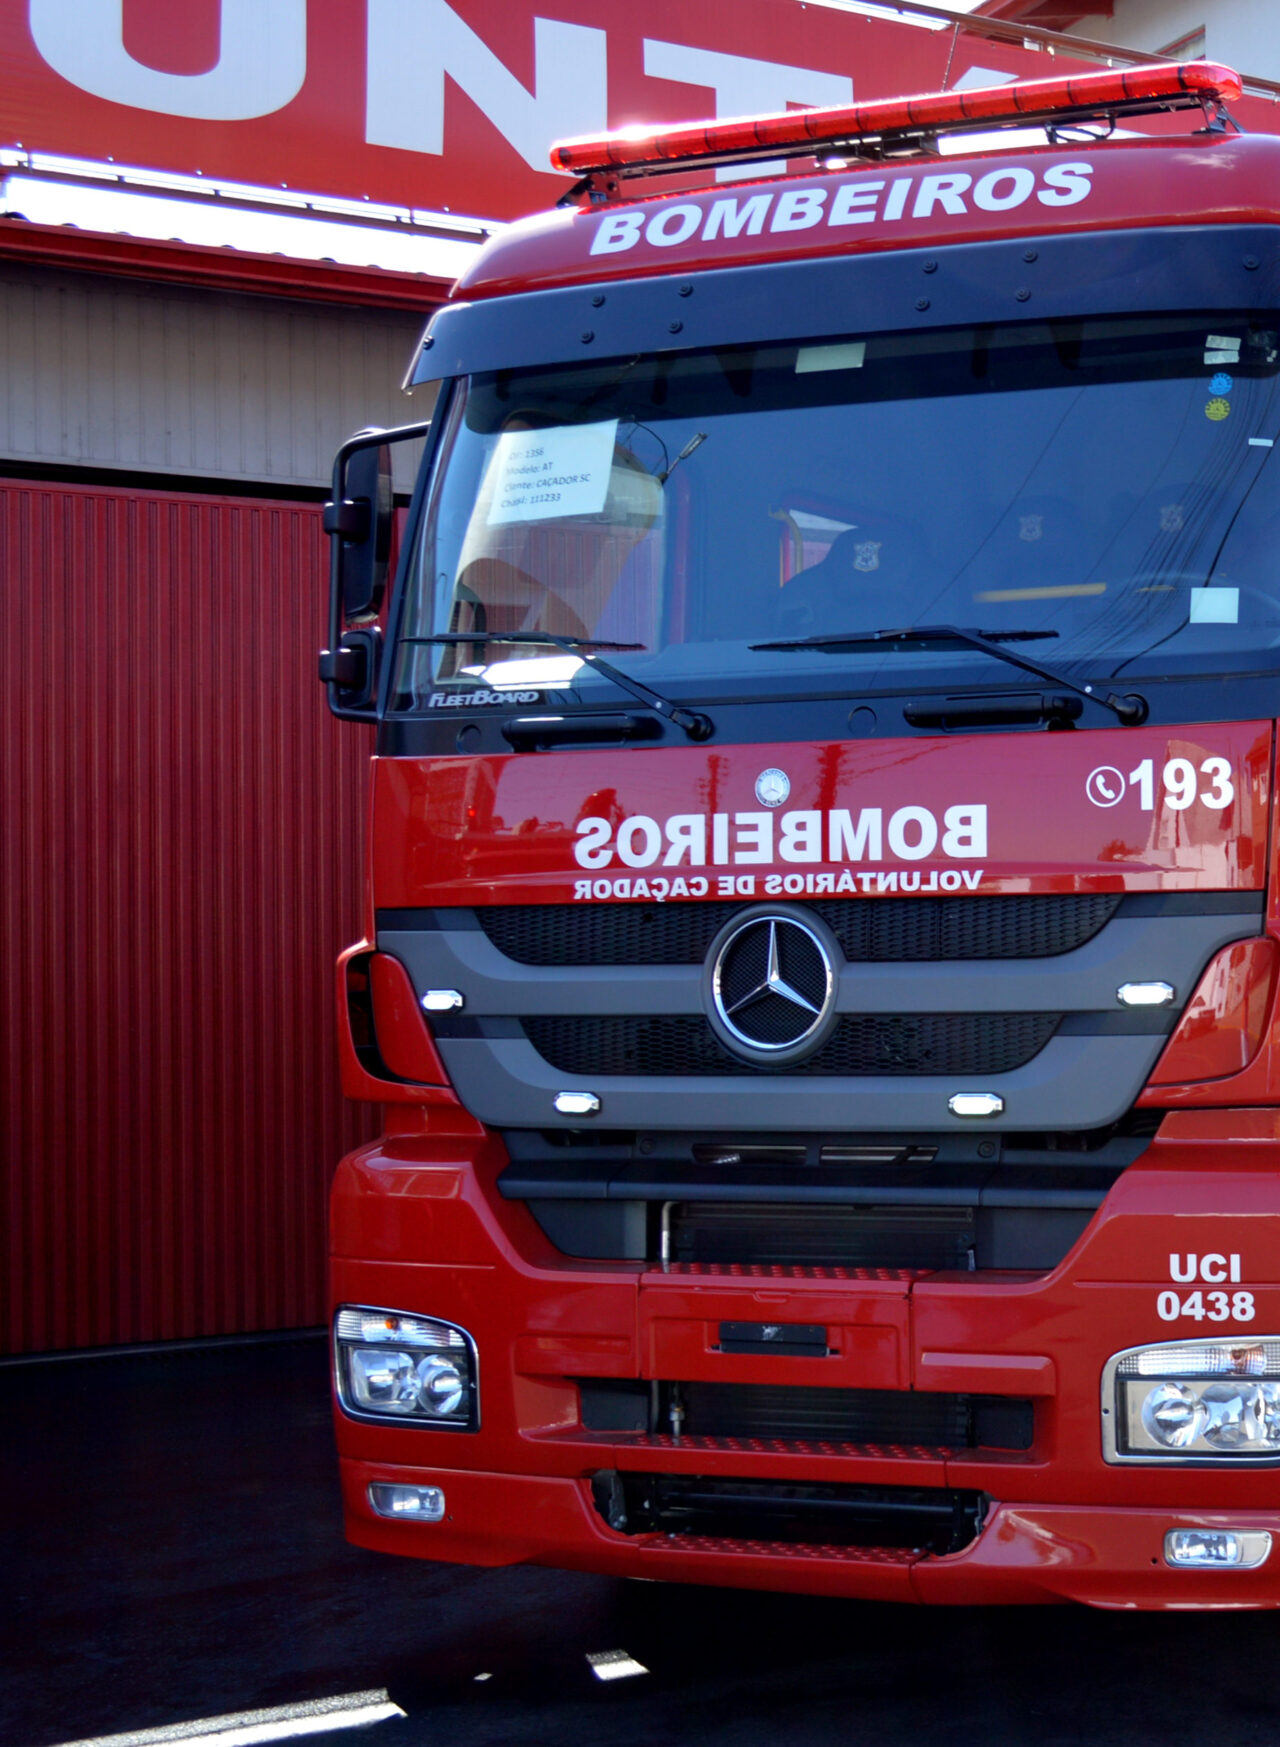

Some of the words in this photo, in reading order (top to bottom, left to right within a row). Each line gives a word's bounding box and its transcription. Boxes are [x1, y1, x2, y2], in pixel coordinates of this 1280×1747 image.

[589, 162, 1094, 256] BOMBEIROS
[536, 474, 579, 488] CAÇADOR
[579, 473, 592, 482] SC
[542, 461, 554, 471] AT
[1129, 757, 1234, 810] 193
[1169, 1253, 1242, 1283] UCI
[1157, 1290, 1256, 1322] 0438
